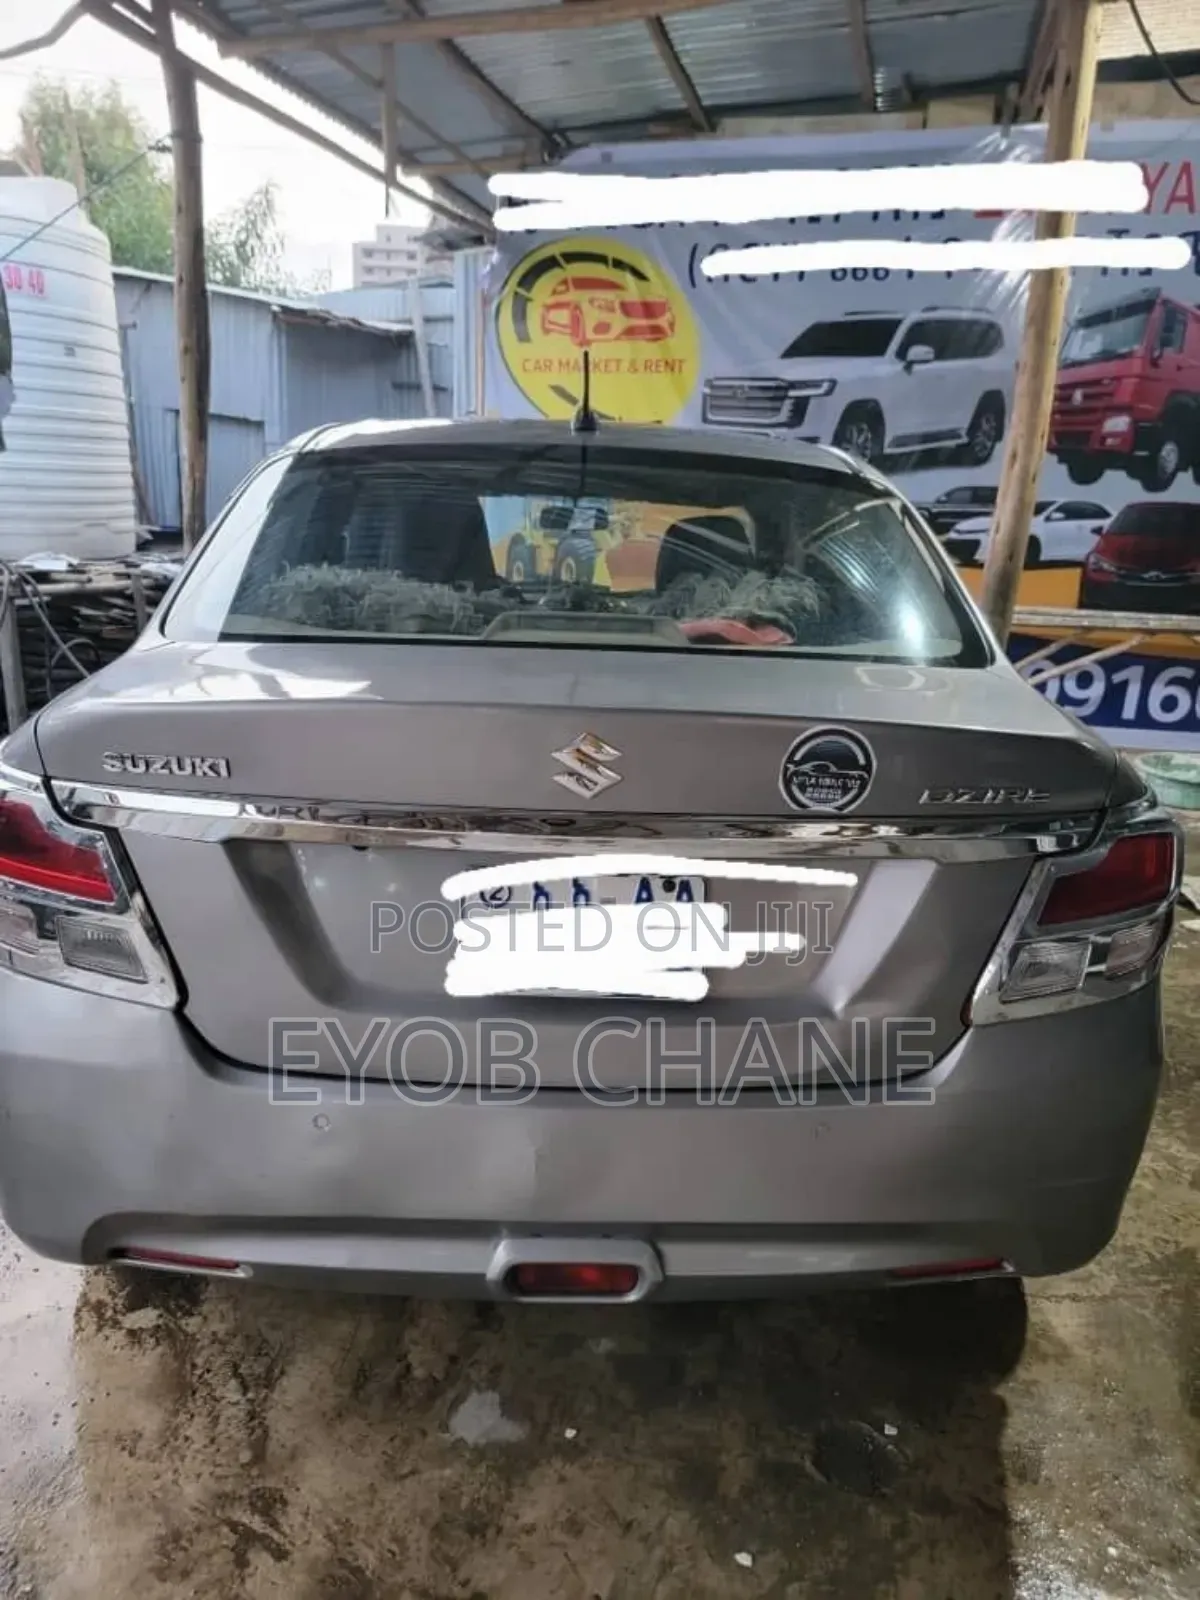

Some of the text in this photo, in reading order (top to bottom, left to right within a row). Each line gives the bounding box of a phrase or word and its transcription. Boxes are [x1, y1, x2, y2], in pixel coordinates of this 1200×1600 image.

[521, 358, 687, 374] CAR MAKET & RENT
[1017, 658, 1200, 724] 0916
[102, 751, 231, 778] SUZUKI
[918, 788, 1050, 804] DZIRE
